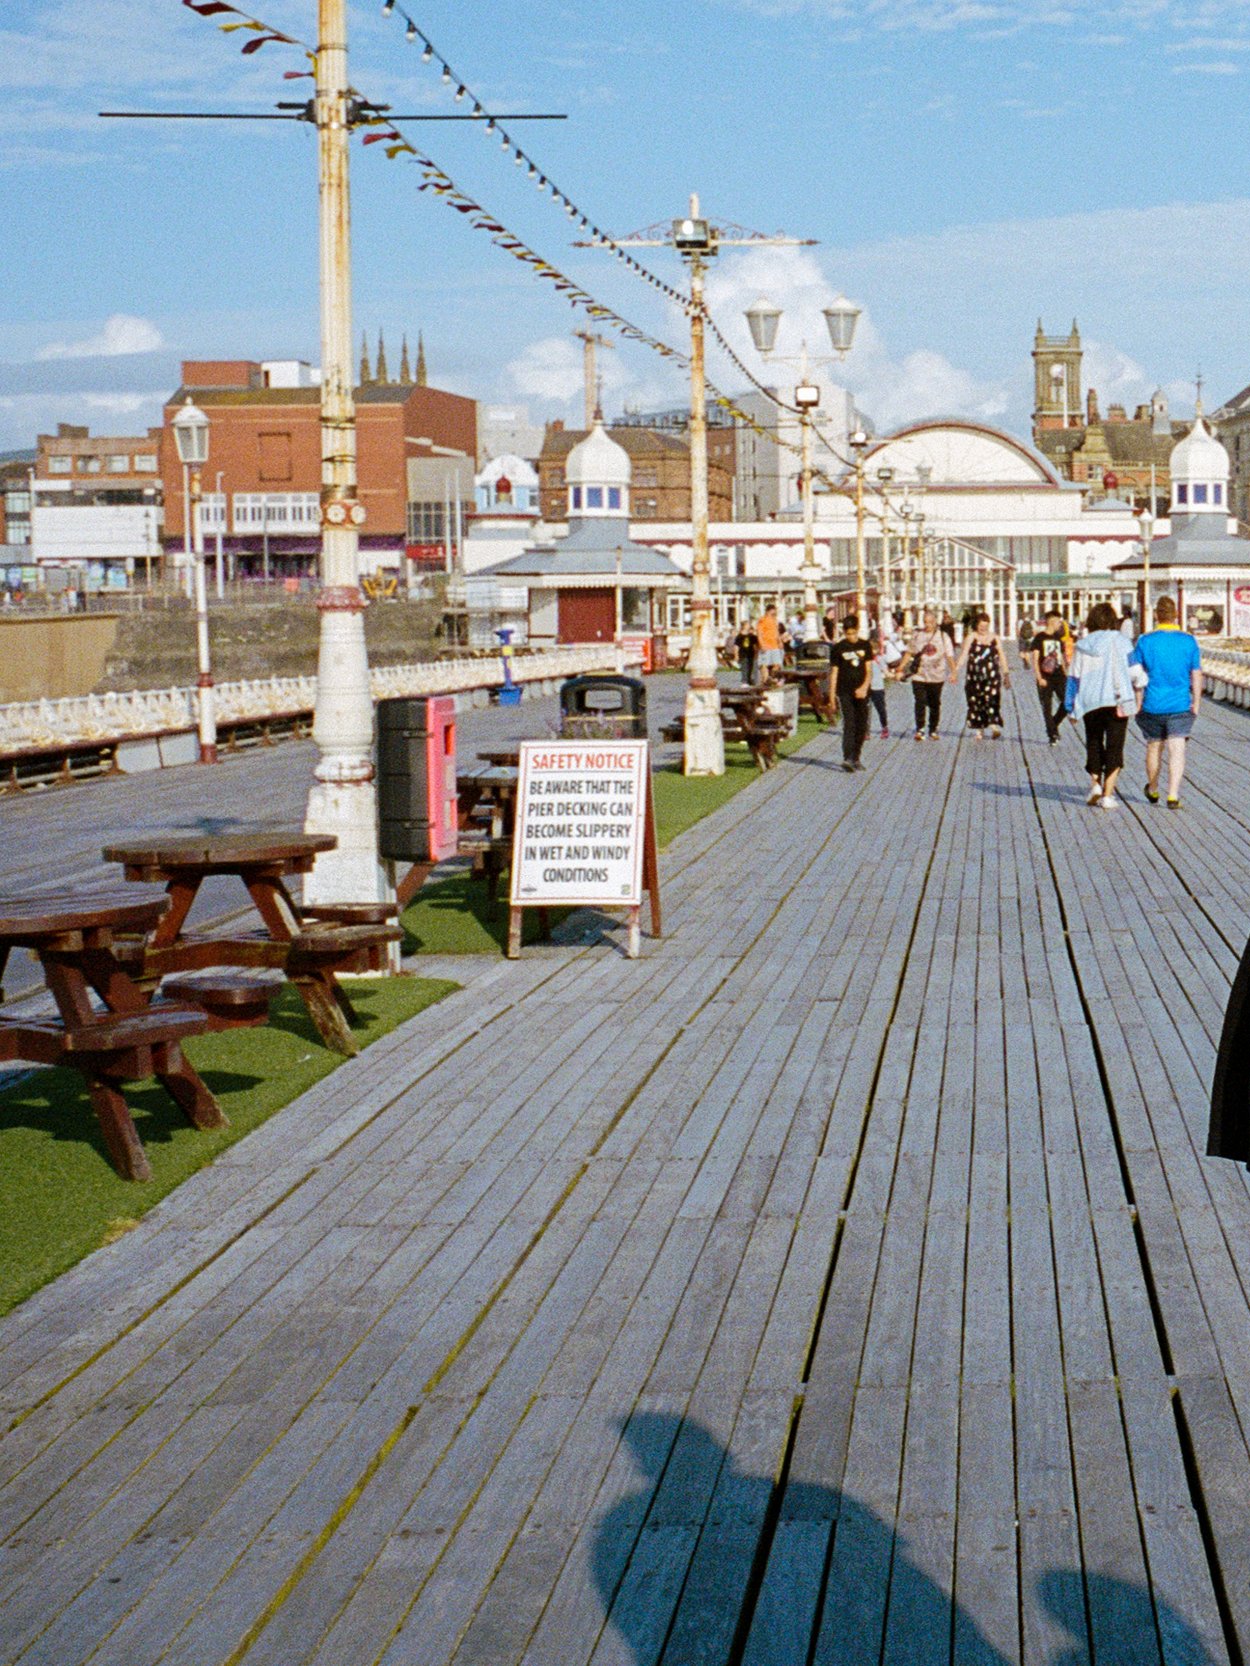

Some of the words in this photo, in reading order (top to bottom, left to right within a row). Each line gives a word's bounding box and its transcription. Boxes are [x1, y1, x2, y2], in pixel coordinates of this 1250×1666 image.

[532, 753, 582, 769] SAFETY
[585, 753, 634, 769] NOTICE
[529, 780, 543, 795] BE
[544, 780, 583, 795] AWARE
[585, 780, 611, 795] THAT
[613, 780, 633, 795] THE
[528, 802, 554, 817] PIER
[557, 802, 607, 817] DECKING
[609, 802, 633, 816] CAN
[526, 824, 574, 839] BECOME
[576, 824, 631, 838] SLIPPERY
[525, 846, 537, 860] IN
[539, 846, 564, 860] WET
[565, 846, 590, 860] AND
[592, 846, 631, 860] WINDY
[543, 868, 608, 883] CONDITIONS
